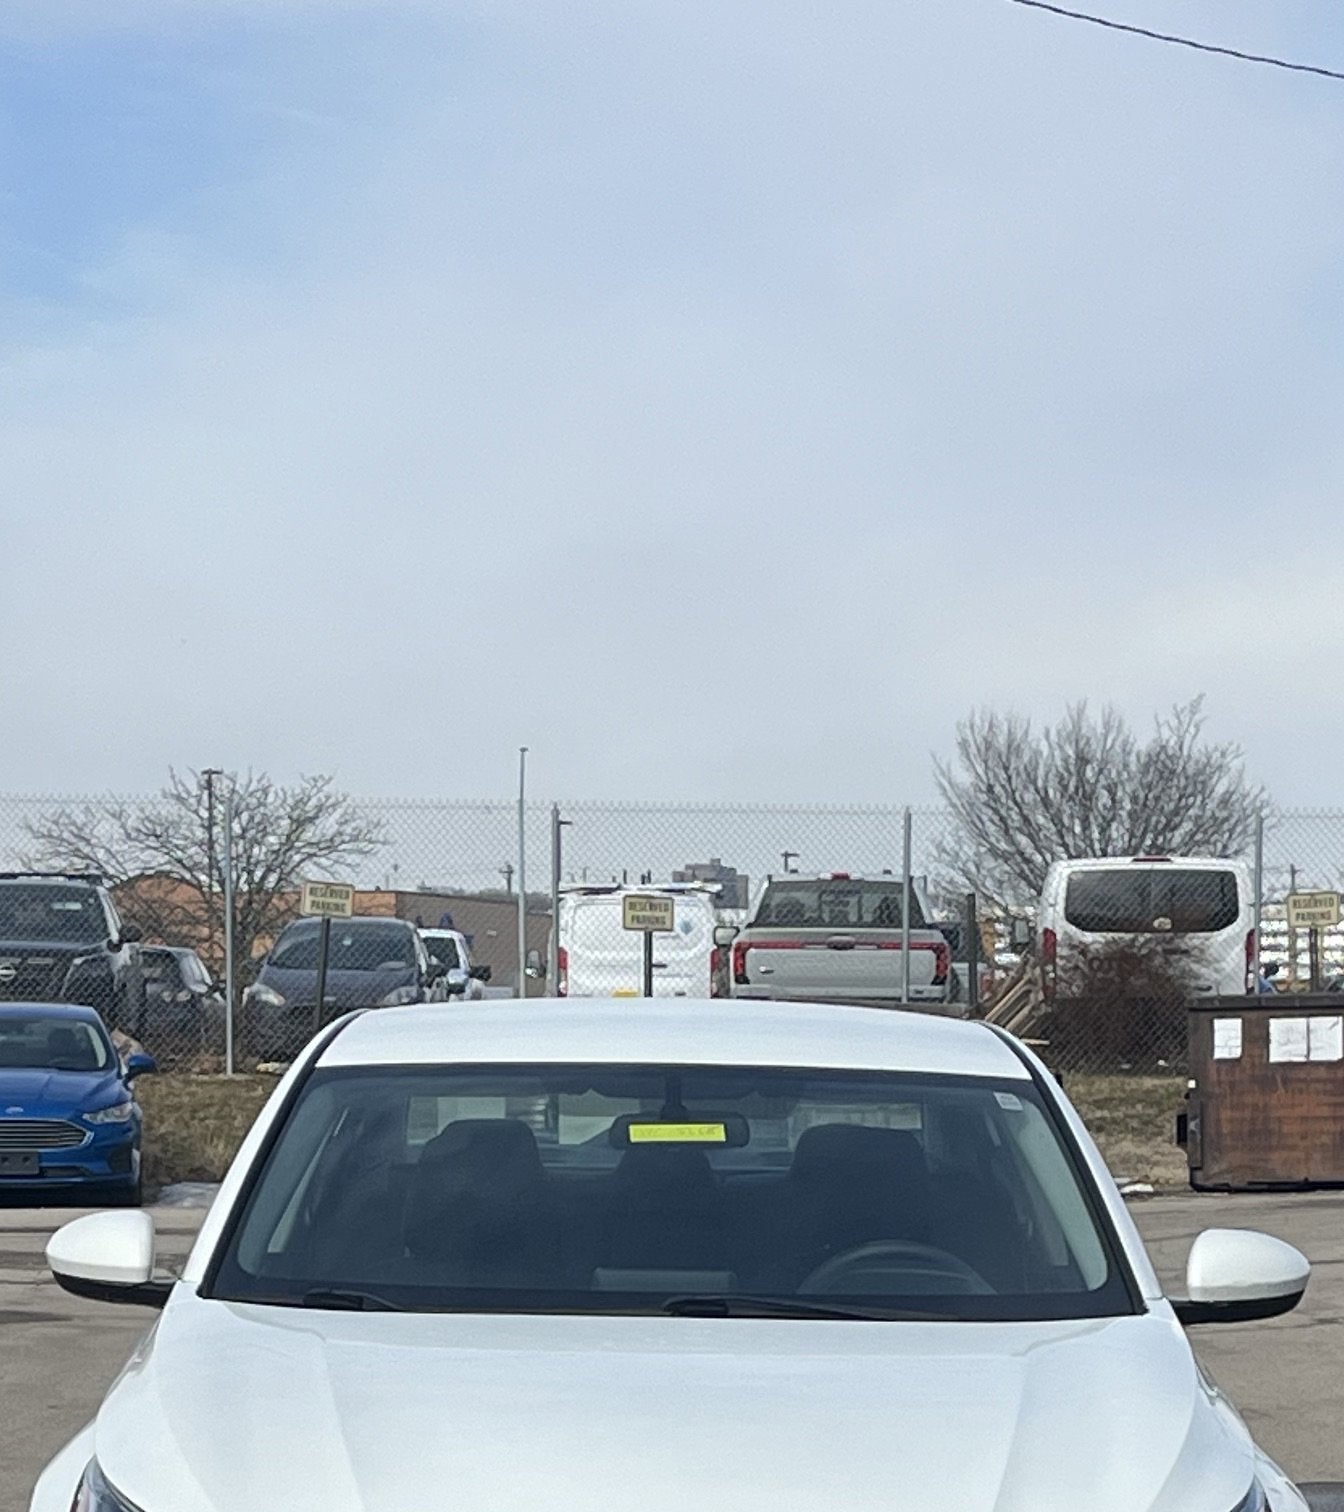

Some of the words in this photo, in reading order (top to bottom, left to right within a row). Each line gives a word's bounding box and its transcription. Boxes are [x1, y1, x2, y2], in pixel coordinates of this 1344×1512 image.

[309, 886, 350, 900] RESERVED
[311, 900, 346, 914] PARKING
[629, 901, 670, 913] RESERVED
[1293, 897, 1334, 909] RESERVED
